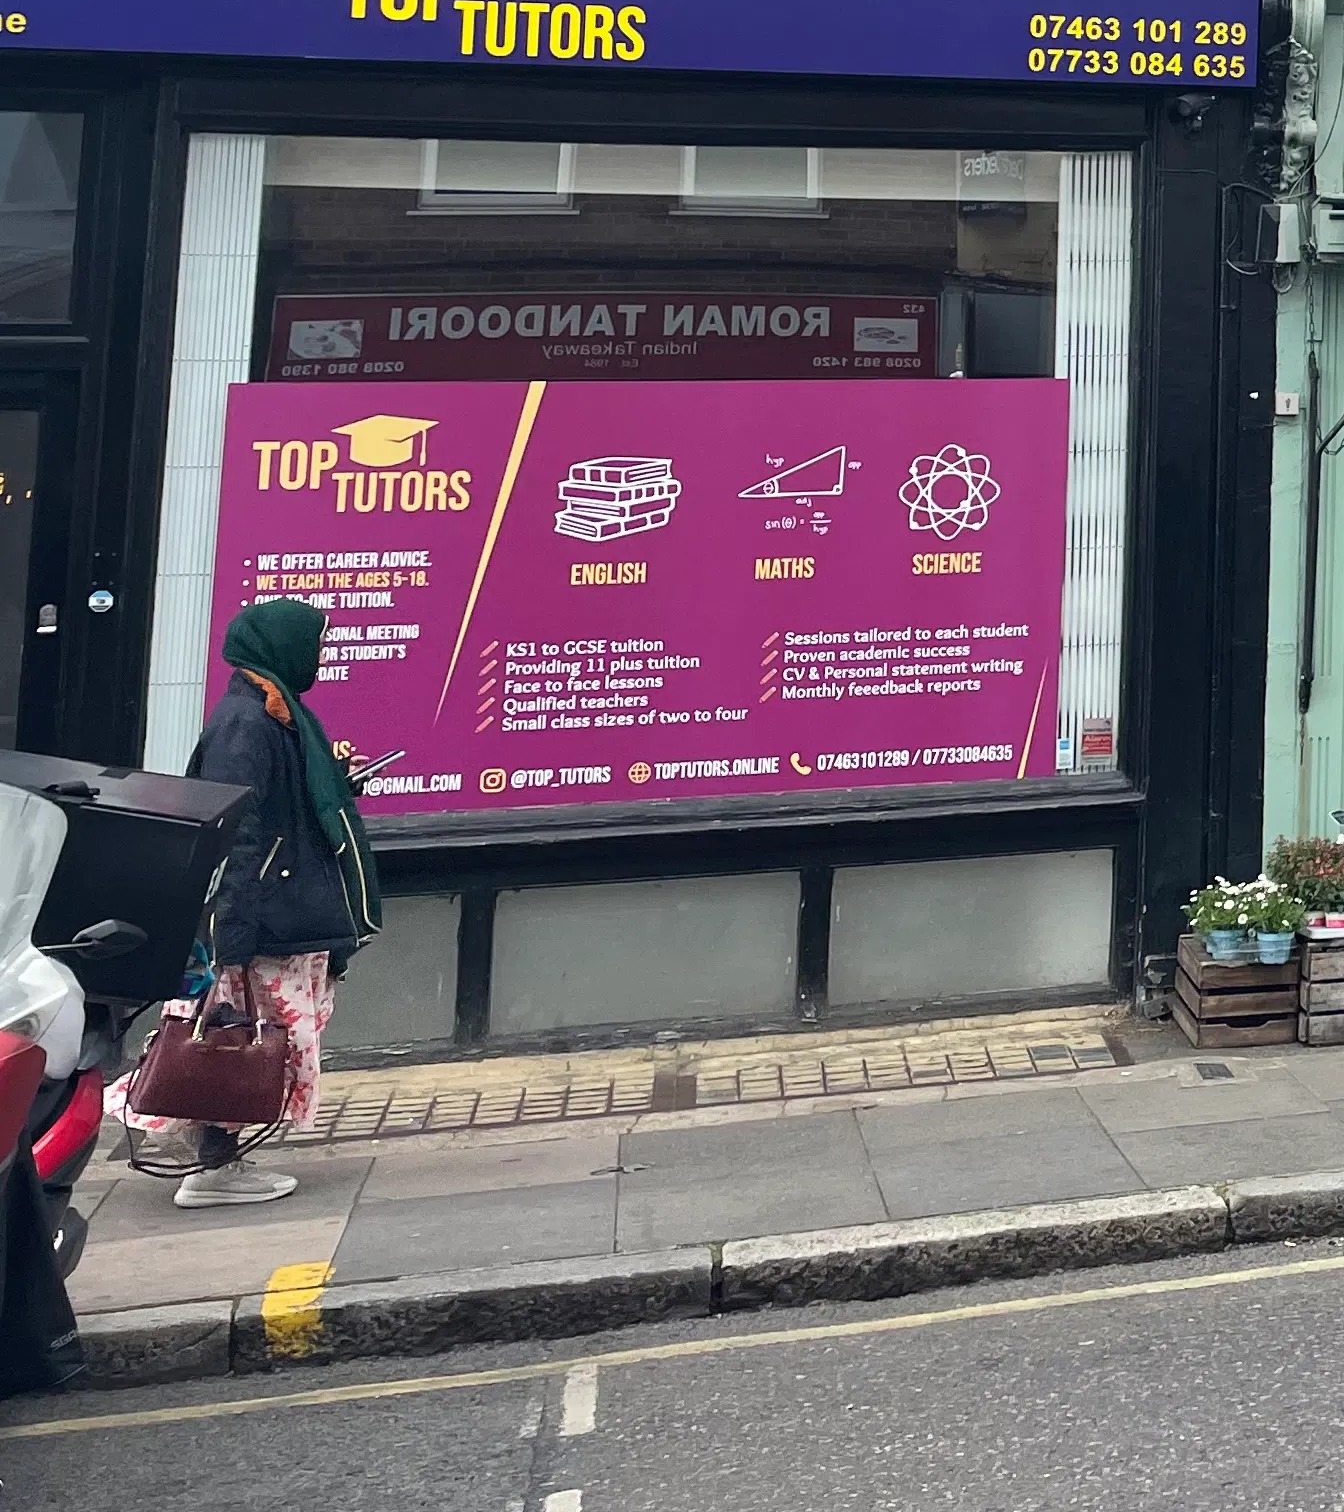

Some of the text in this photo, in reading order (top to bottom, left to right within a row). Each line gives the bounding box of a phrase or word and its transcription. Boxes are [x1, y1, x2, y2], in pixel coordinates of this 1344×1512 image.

[453, 0, 647, 62] TUTORS
[1029, 14, 1247, 46] 07463 101 289
[1028, 47, 1245, 78] 07733 084 635
[252, 440, 338, 491] TOP
[331, 470, 472, 513] TUTORS
[257, 550, 432, 571] WE OFFER CAREER ADVICE.
[754, 557, 815, 580] MATHS
[912, 552, 983, 575] SCIENCE
[256, 571, 430, 590] WE TEACH THE AGES 5-18.
[570, 562, 647, 585] ENGLISH
[339, 591, 395, 608] TUITION.
[366, 624, 420, 640] MEETING
[784, 623, 1029, 646] Sessions tailored to each student
[340, 644, 407, 661] STUDENT'S
[506, 638, 664, 658] KS1 to GCSE tuition
[784, 645, 971, 663] Proven academic success
[505, 655, 700, 677] Providing 11 plus tuition
[782, 658, 1024, 681] CV & Personal statement writing
[504, 674, 664, 694] Face to face lessons
[782, 682, 845, 701] Monthly
[927, 679, 982, 696] reports
[503, 694, 648, 715] Qualified teachers
[502, 706, 748, 732] Small class sizes of two to four
[510, 766, 612, 789] @TOP_TUTORS
[654, 756, 780, 780] TOPTUTORS.ONLINE
[817, 748, 910, 771] 07463101289
[922, 744, 1013, 766] 07733084635
